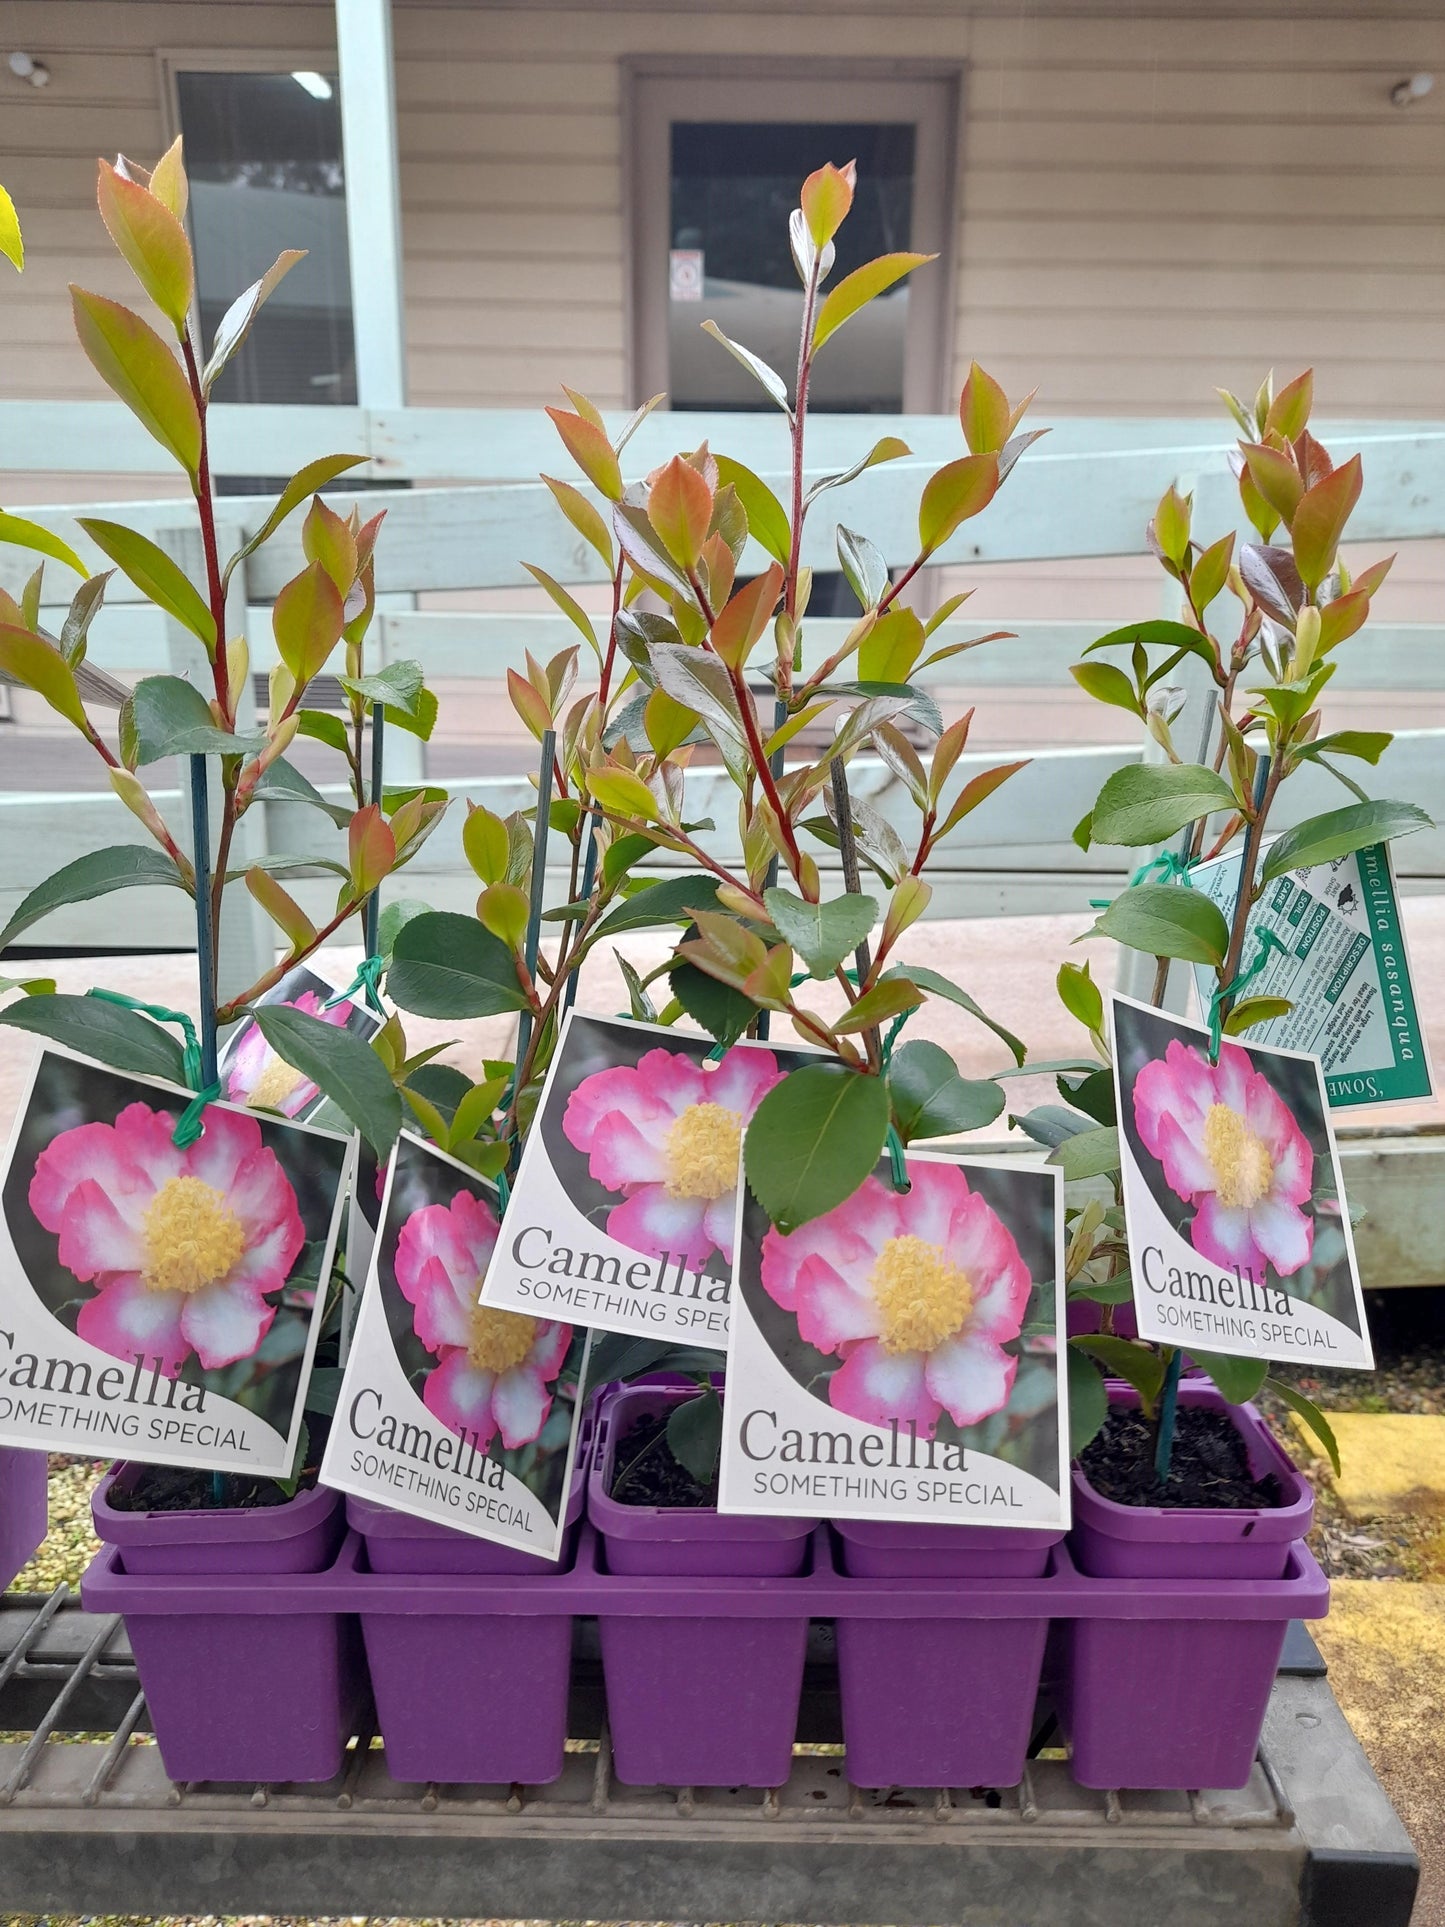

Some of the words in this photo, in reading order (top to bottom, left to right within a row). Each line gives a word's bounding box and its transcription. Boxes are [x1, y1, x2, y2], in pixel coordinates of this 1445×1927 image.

[1274, 881, 1291, 908] CARE:
[1323, 876, 1335, 894] SHADE
[1330, 883, 1340, 897] PART
[1292, 895, 1307, 918] SOIL:
[1300, 909, 1325, 950] POSITION:
[1366, 844, 1390, 930] amellia
[1381, 943, 1414, 1061] sasanqua
[1328, 937, 1366, 997] DESCRIPTION:
[1336, 1001, 1347, 1014] and
[1351, 997, 1360, 1006] for
[1360, 986, 1377, 1009] flowers
[1323, 1013, 1340, 1036] hedges.
[1352, 1009, 1364, 1023] with
[1357, 1009, 1374, 1029] Large,
[1337, 1034, 1348, 1049] pink
[1344, 1022, 1355, 1036] rose
[1349, 1029, 1362, 1045] white
[1320, 1039, 1336, 1062] screenin
[1337, 1044, 1353, 1063] single
[511, 1226, 730, 1304] Camellia
[1142, 1246, 1294, 1316] Camellia
[517, 1277, 666, 1323] SOMETHING
[1157, 1304, 1256, 1339] SOMETHING
[1261, 1322, 1338, 1349] SPECIAL
[0, 1330, 207, 1413] amellia
[0, 1397, 139, 1436] OMETHING
[147, 1418, 251, 1451] SPECIAL
[349, 1388, 507, 1492] Camellia
[739, 1409, 969, 1472] Camellia
[350, 1449, 461, 1507] SOMETHING
[464, 1491, 533, 1533] SPECIAL
[753, 1472, 907, 1502] SOMETHING
[916, 1480, 1023, 1508] SPECIAL
